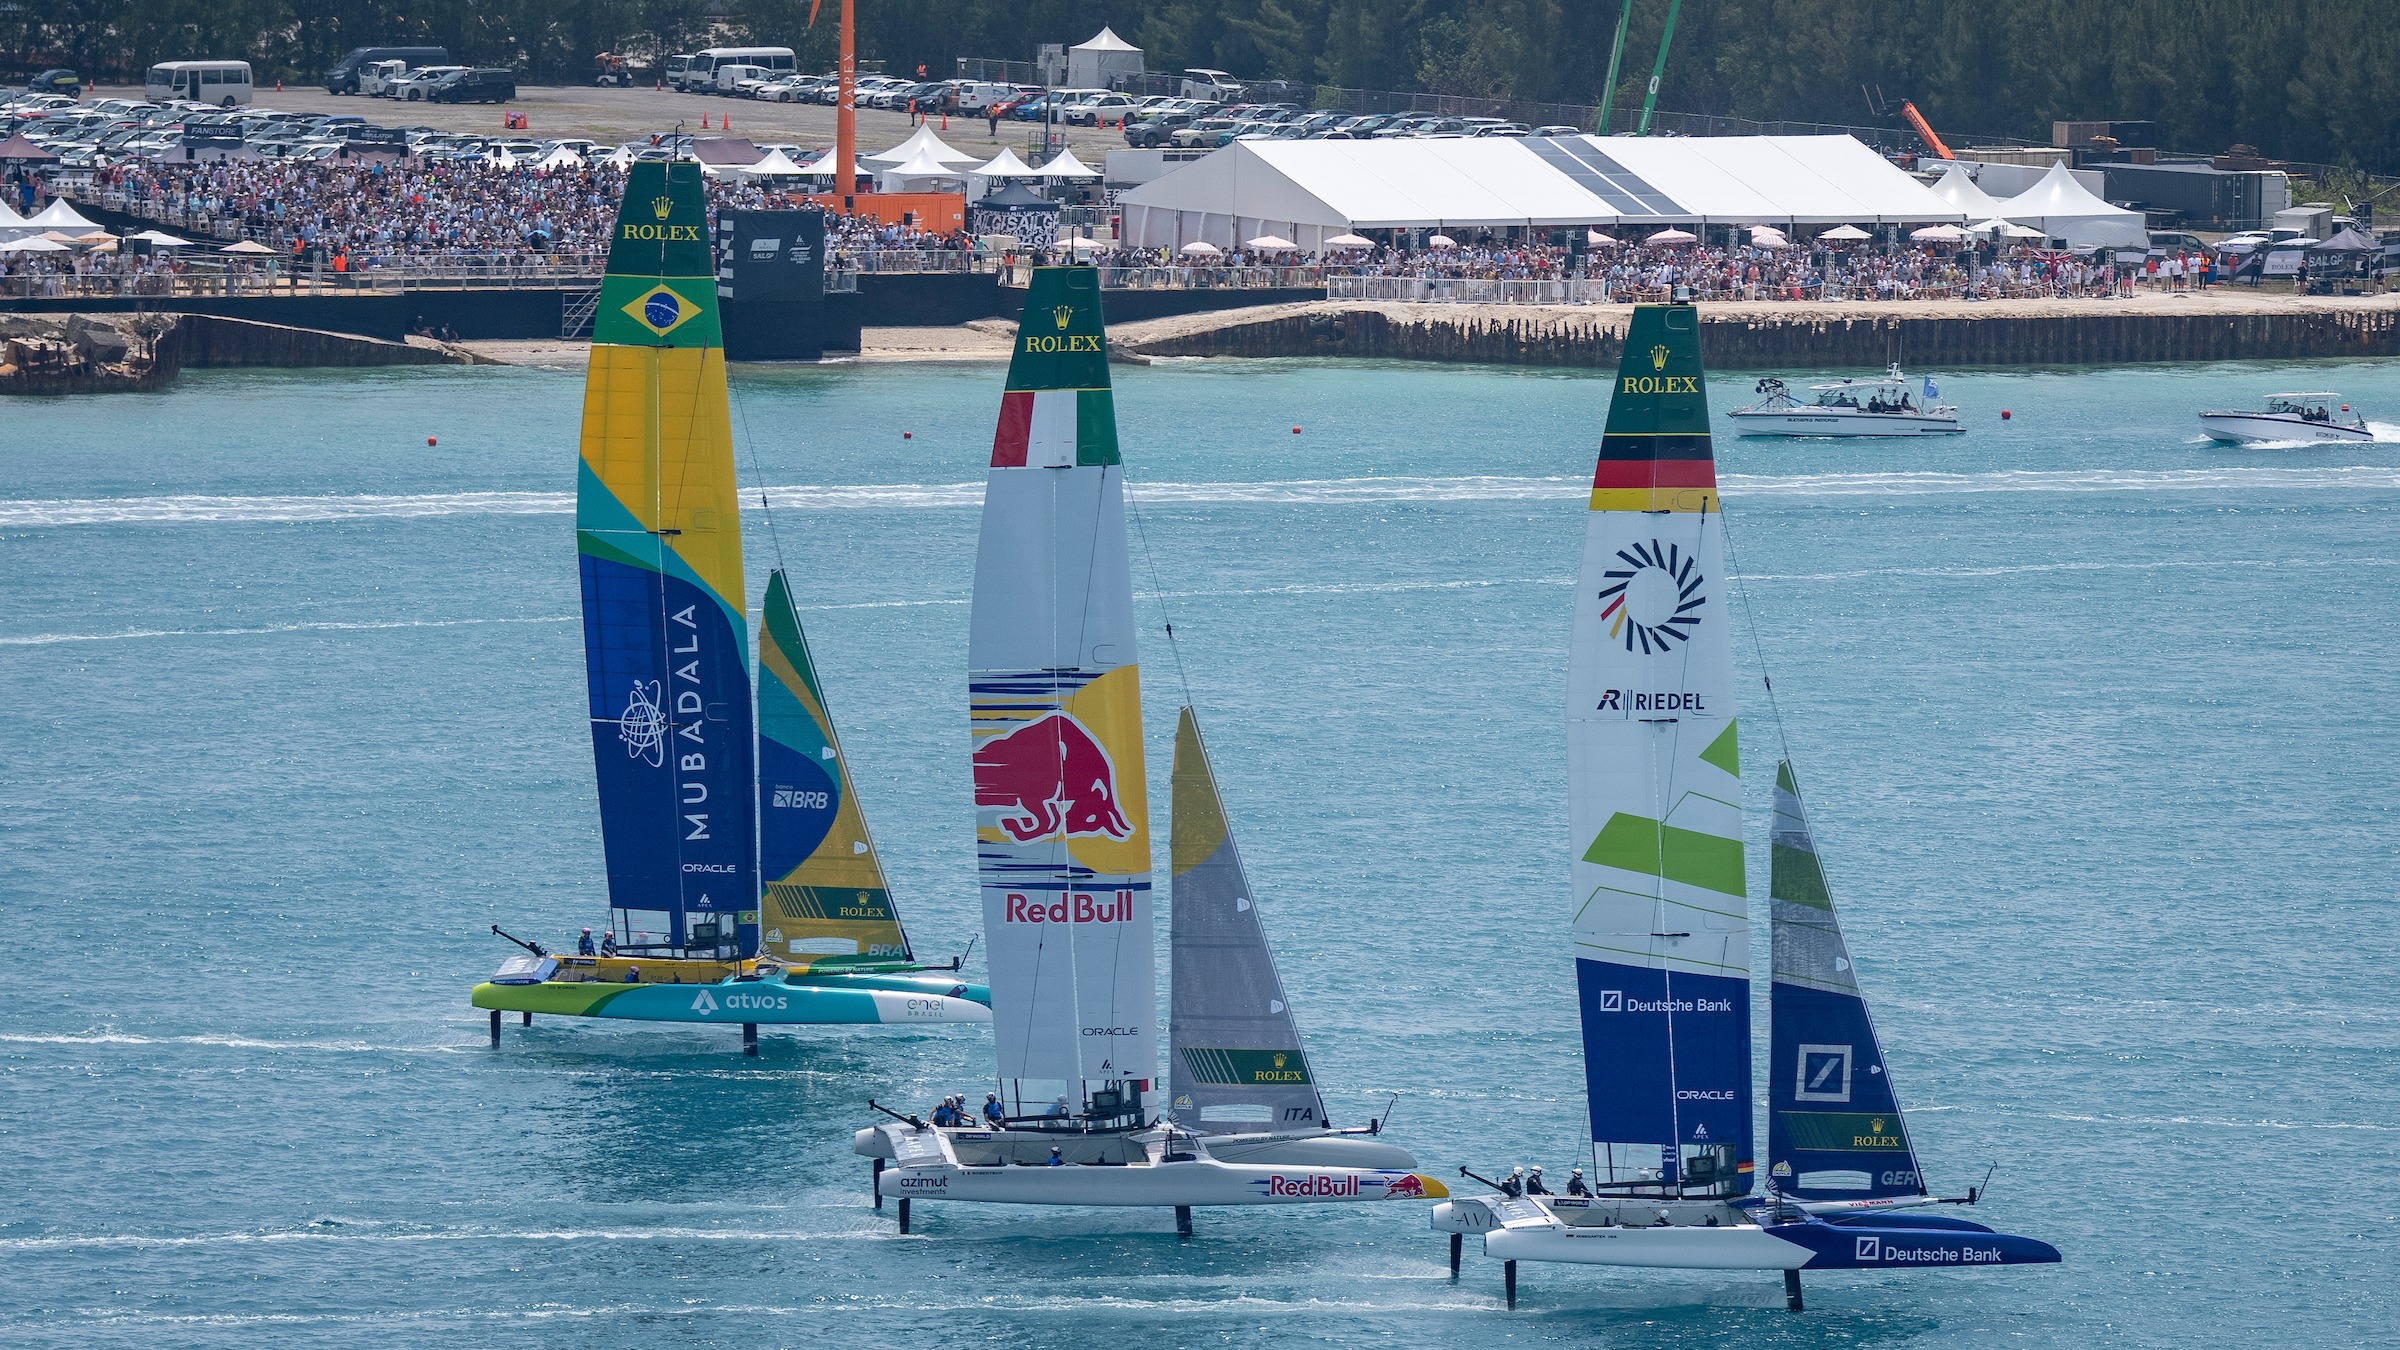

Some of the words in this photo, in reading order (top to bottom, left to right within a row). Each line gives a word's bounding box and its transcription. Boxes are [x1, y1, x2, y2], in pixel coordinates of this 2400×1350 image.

[844, 53, 854, 99] APEX
[191, 127, 238, 135] FANSTORE
[623, 224, 700, 241] ROLEX
[1025, 335, 1101, 353] ROLEX
[1622, 376, 1699, 394] ROLEX
[1635, 693, 1705, 711] RIEDEL
[672, 604, 710, 841] MUBADALA
[792, 791, 829, 810] BRB
[682, 863, 736, 873] ORACLE
[840, 906, 885, 917] ROLEX
[1006, 892, 1069, 923] Red
[1074, 890, 1133, 922] Bull
[867, 943, 904, 957] BRA
[725, 994, 788, 1010] atvos
[906, 998, 945, 1011] enel
[1627, 998, 1693, 1013] Deutsche
[1697, 998, 1732, 1013] Bank
[1082, 1026, 1139, 1036] ORACLE
[1254, 1069, 1303, 1081] ROLEX
[1677, 1089, 1735, 1101] ORACLE
[1283, 1107, 1314, 1122] ITA
[1853, 1135, 1899, 1148] ROLEX
[900, 1172, 948, 1188] azimut
[1270, 1175, 1315, 1197] Red
[1317, 1174, 1360, 1197] Bull
[1880, 1170, 1916, 1187] GER
[1885, 1246, 1959, 1262] Deutsche
[1962, 1246, 2002, 1262] Bank
